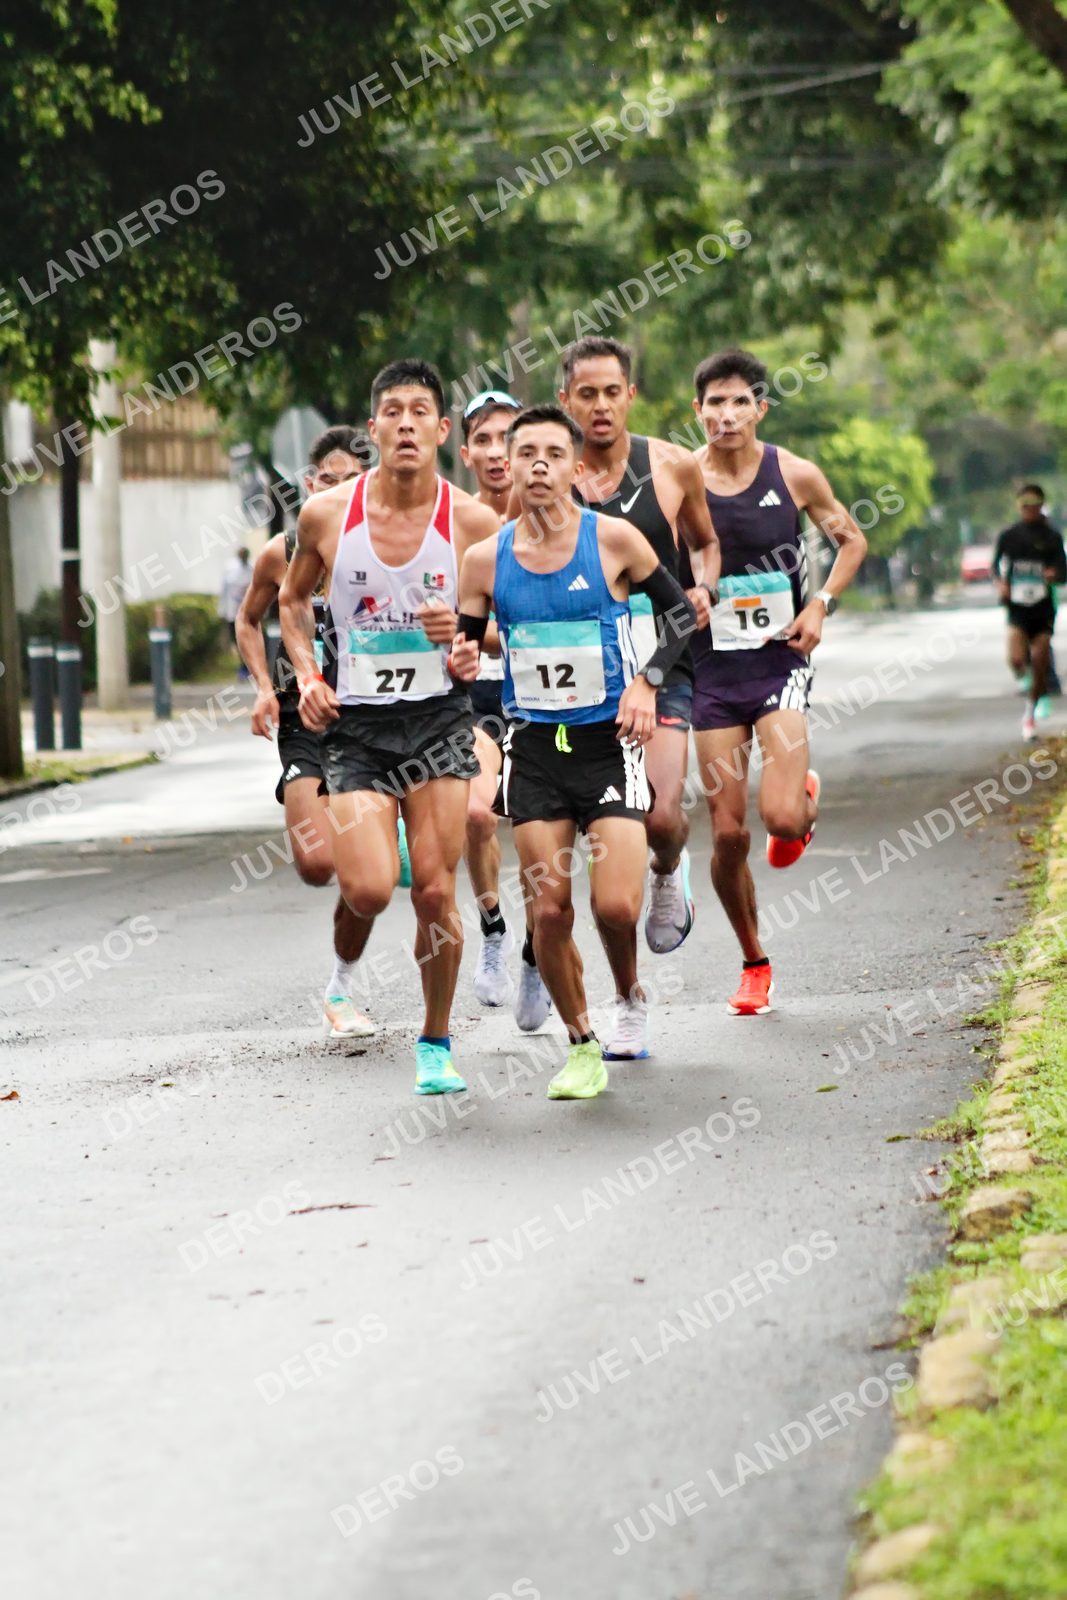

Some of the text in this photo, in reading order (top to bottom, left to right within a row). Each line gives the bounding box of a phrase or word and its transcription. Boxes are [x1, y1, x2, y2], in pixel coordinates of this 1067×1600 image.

[734, 607, 770, 630] 16
[375, 668, 416, 693] 27
[536, 663, 576, 689] 12
